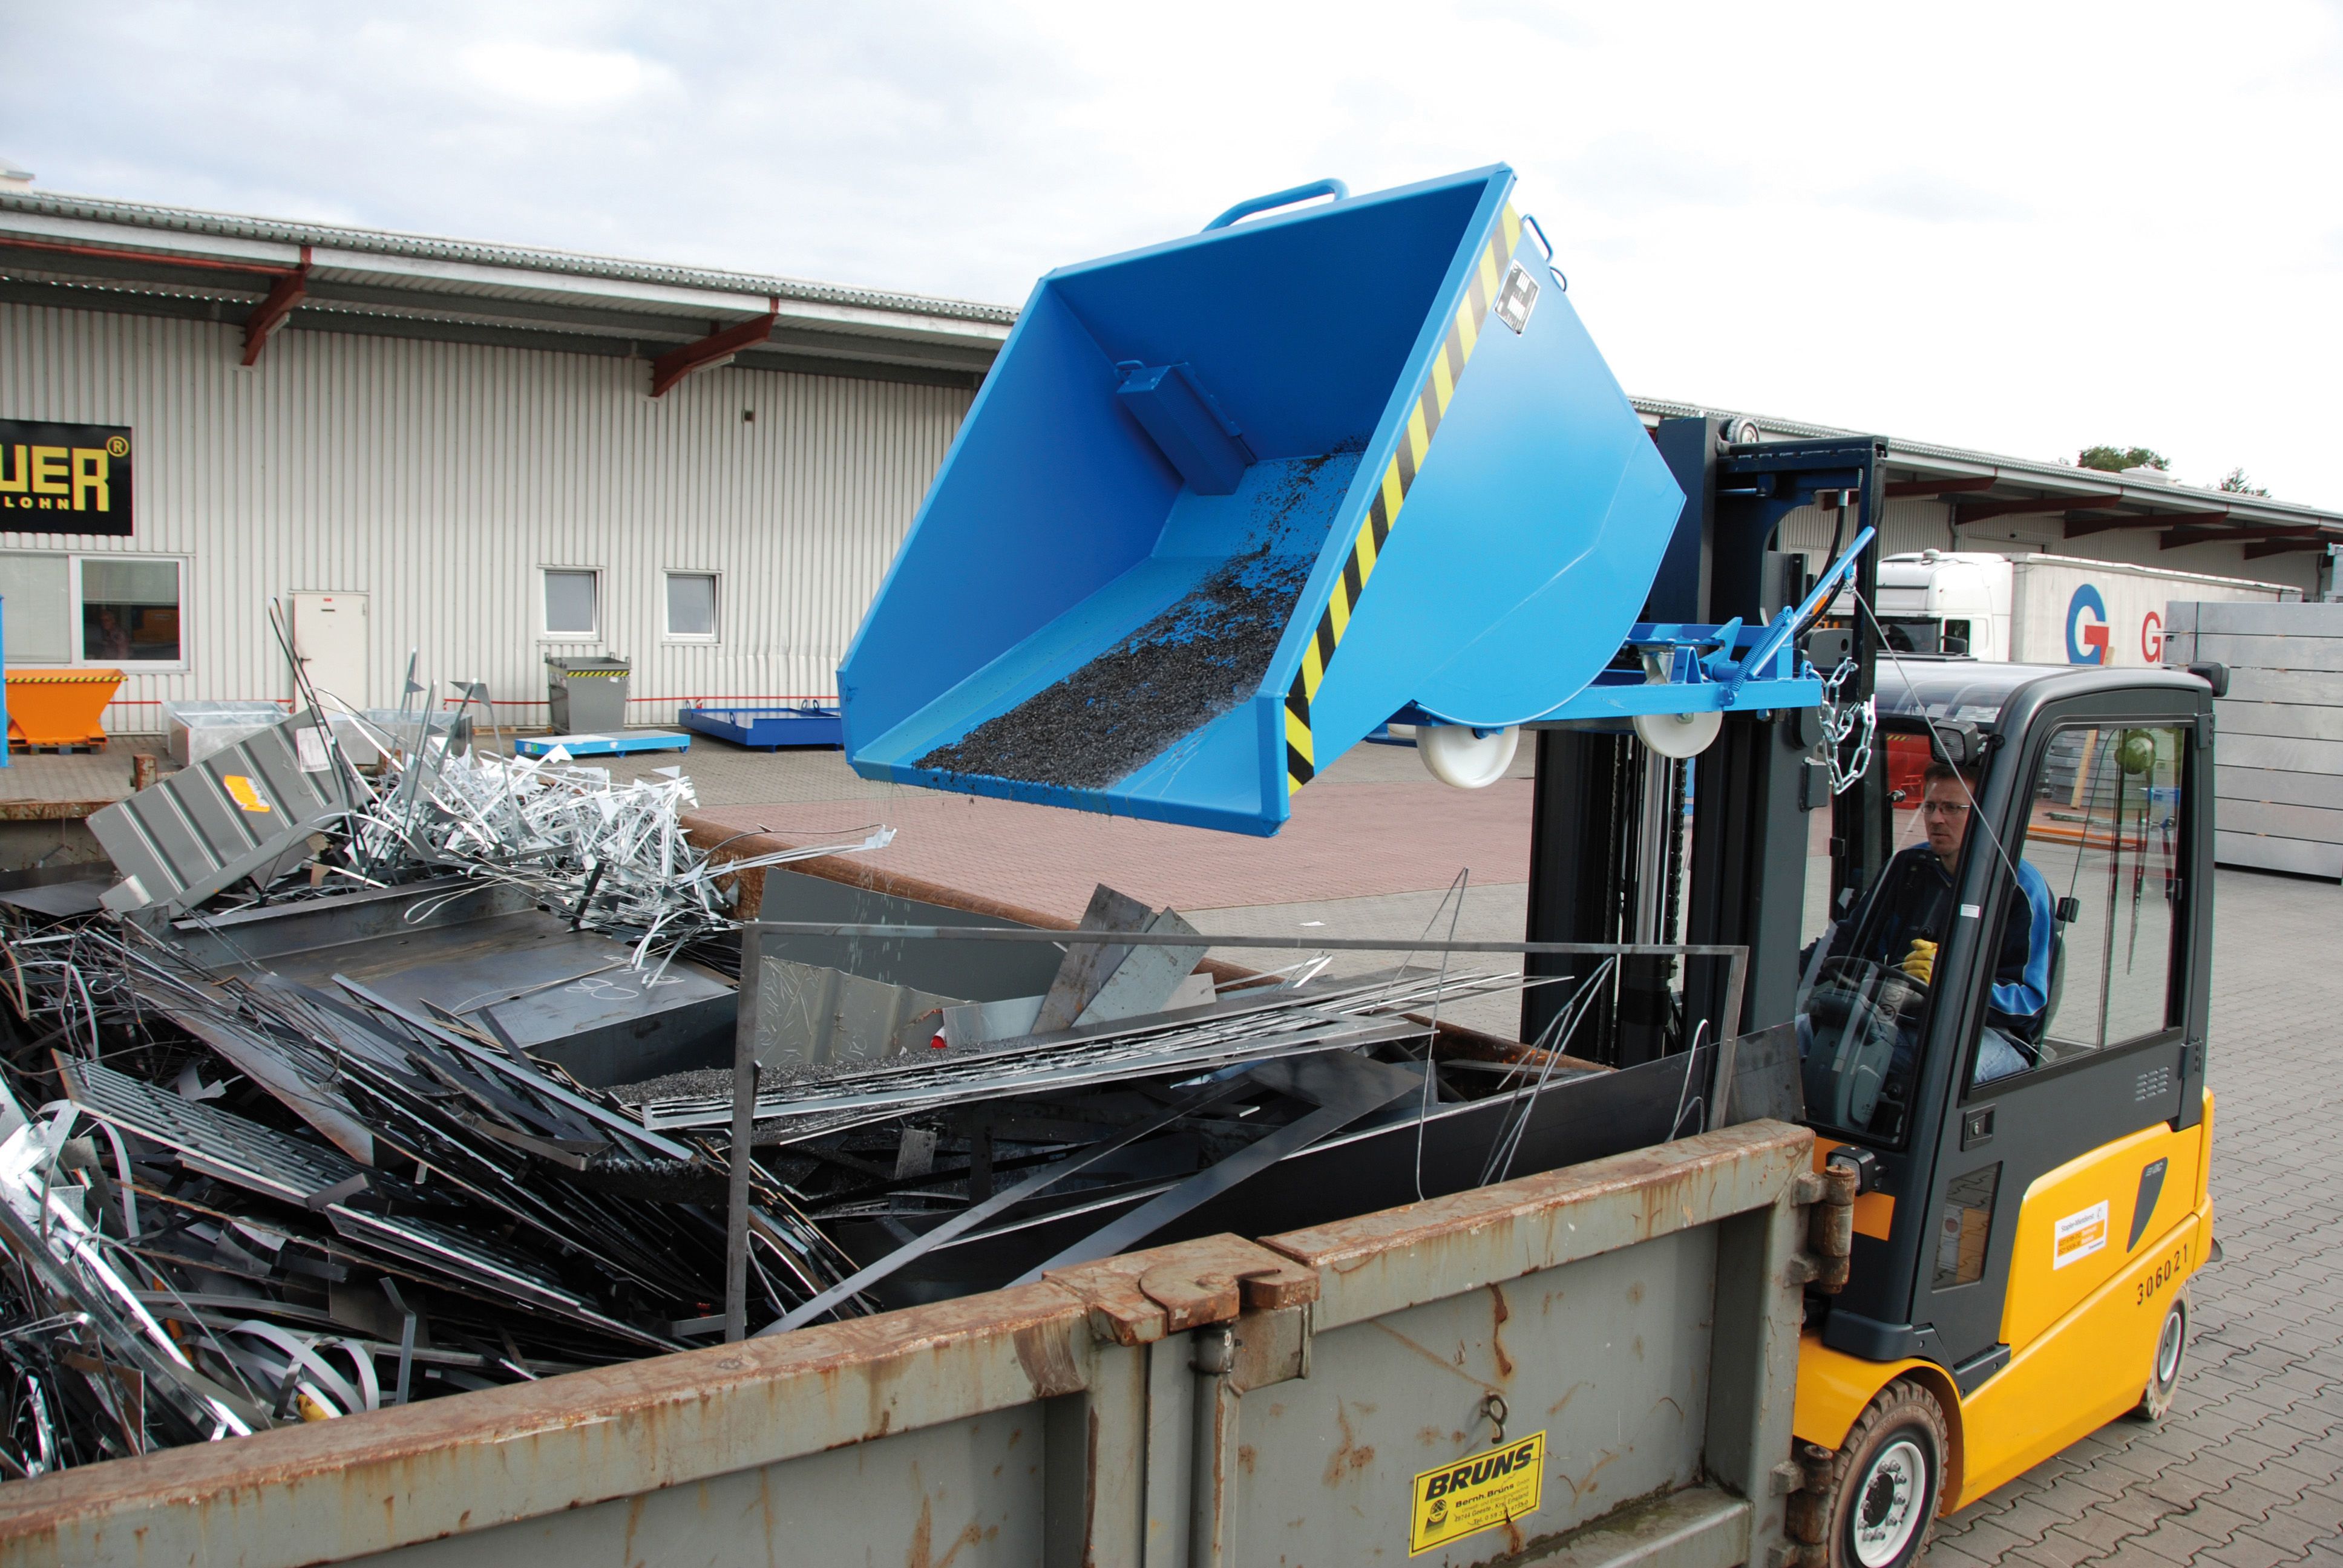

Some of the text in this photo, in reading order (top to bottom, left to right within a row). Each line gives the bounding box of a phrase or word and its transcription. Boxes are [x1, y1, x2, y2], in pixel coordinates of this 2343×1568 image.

[2137, 1243, 2187, 1305] 306021
[1424, 1442, 1535, 1501] BRUNS
[1487, 1483, 1514, 1497] Bruns
